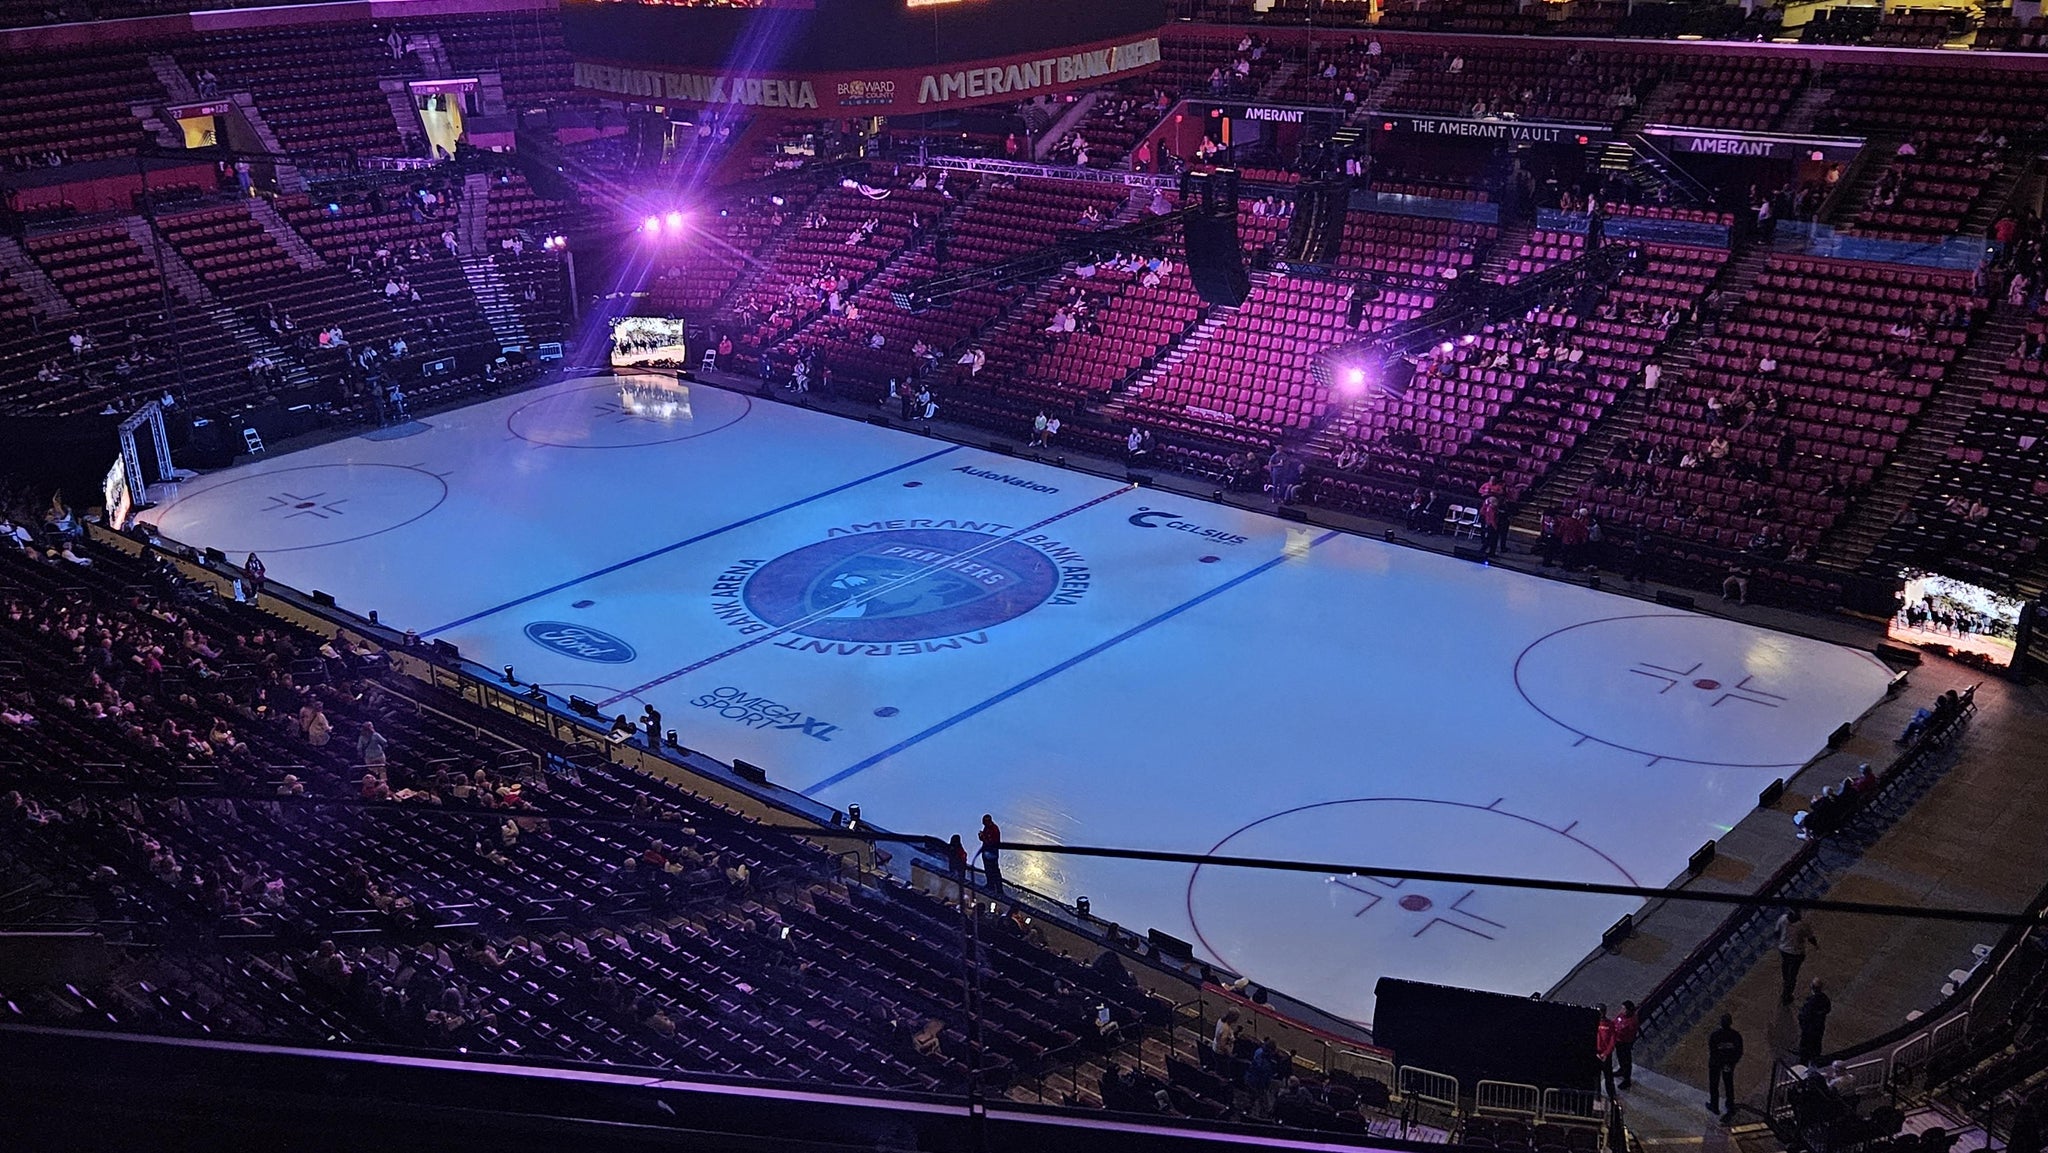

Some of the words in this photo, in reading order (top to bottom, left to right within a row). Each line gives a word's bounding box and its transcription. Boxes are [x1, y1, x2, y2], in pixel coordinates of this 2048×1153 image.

[664, 73, 729, 103] BANK
[730, 78, 819, 109] ARENA
[918, 58, 1056, 103] AMERANT
[1057, 49, 1112, 82] BANK
[1245, 107, 1305, 123] AMERANT
[1412, 119, 1435, 133] THE
[1438, 122, 1507, 139] AMERANT
[1510, 127, 1560, 142] VAULT
[1691, 138, 1774, 156] AMERANT
[951, 465, 1060, 495] AutoNation
[827, 519, 1014, 538] AMERANT
[1165, 521, 1249, 544] CELSIUS
[881, 546, 1004, 586] PANTHERS
[1022, 534, 1086, 566] BANK
[710, 559, 767, 598] ARENA
[1046, 564, 1091, 606] ARENA
[710, 599, 769, 636] BANK
[539, 628, 617, 657] Ford
[773, 631, 989, 658] AMERANT
[689, 694, 783, 730] SPORT
[774, 716, 838, 742] XL
[712, 686, 802, 724] OMEGA
